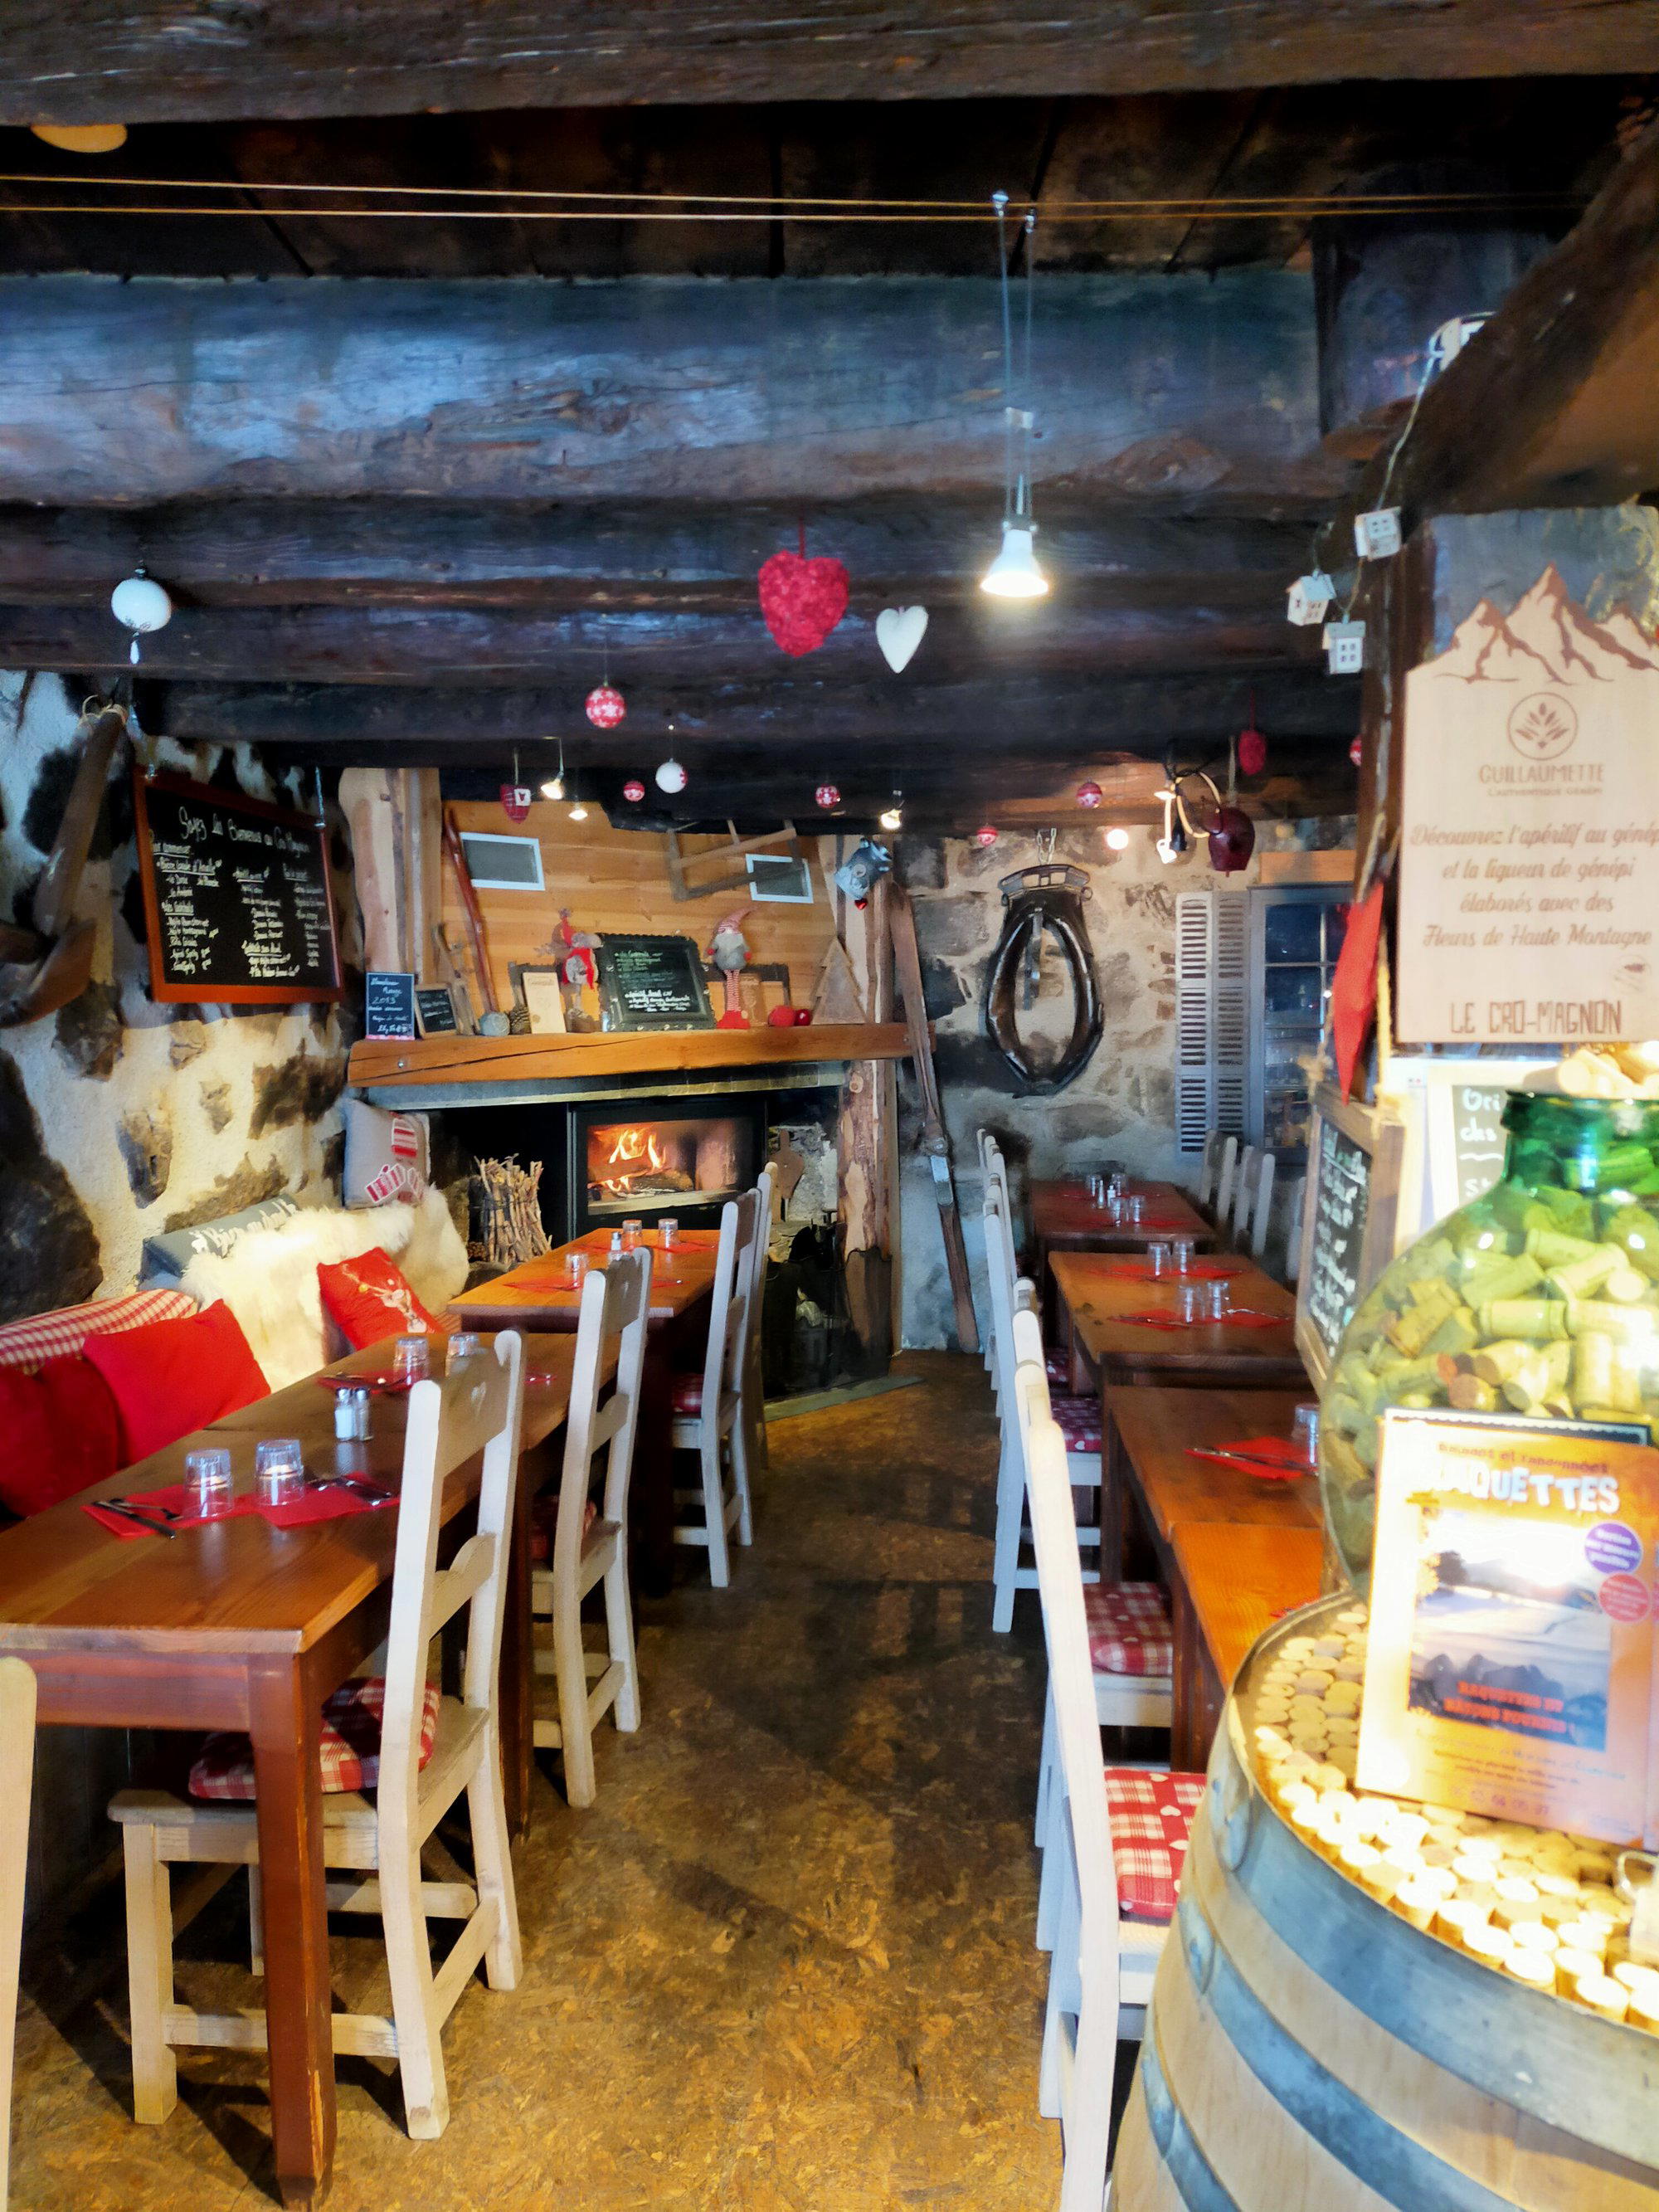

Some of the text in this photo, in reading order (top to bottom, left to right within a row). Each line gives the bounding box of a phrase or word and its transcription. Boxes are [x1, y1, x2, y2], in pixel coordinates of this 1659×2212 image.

[1479, 763, 1604, 784] GUILLAUMETTE
[1584, 830, 1607, 844] au
[1442, 857, 1637, 883] et la liqueur de génépi
[1460, 890, 1614, 913] élaborés avec des
[1423, 923, 1652, 949] Fleurs de Haute Montagne
[1451, 1000, 1622, 1034] LE CRO-MAGNON
